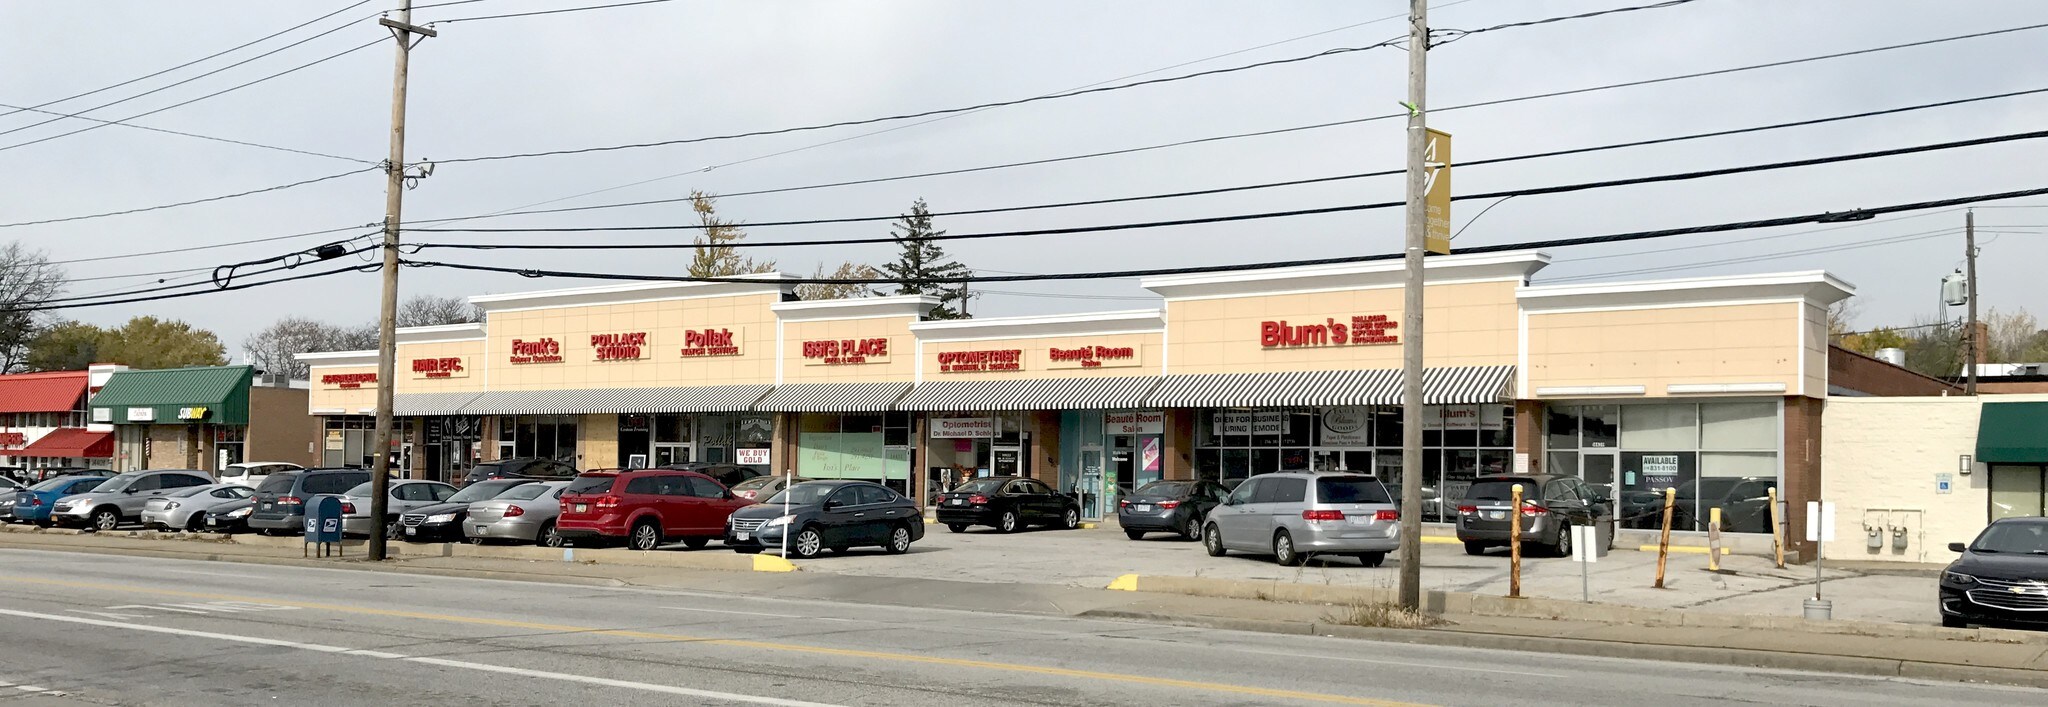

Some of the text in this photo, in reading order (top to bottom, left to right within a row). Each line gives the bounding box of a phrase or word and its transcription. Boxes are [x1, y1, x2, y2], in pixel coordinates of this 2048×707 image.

[591, 332, 646, 346] POLLACK
[685, 328, 733, 347] Pollak
[1261, 318, 1348, 347] Blum's
[511, 338, 559, 354] Frank's
[596, 346, 641, 359] STUDIO
[803, 338, 887, 357] ISSI'S PLACE
[1050, 346, 1133, 360] Beauté Room
[938, 350, 1021, 363] OPTOMETRIST
[413, 357, 463, 371] HAIR ETC.
[178, 407, 207, 419] SUBWAY
[1105, 413, 1161, 423] Beauté Room
[943, 421, 992, 429] Optometrist
[1250, 424, 1285, 432] EMODE
